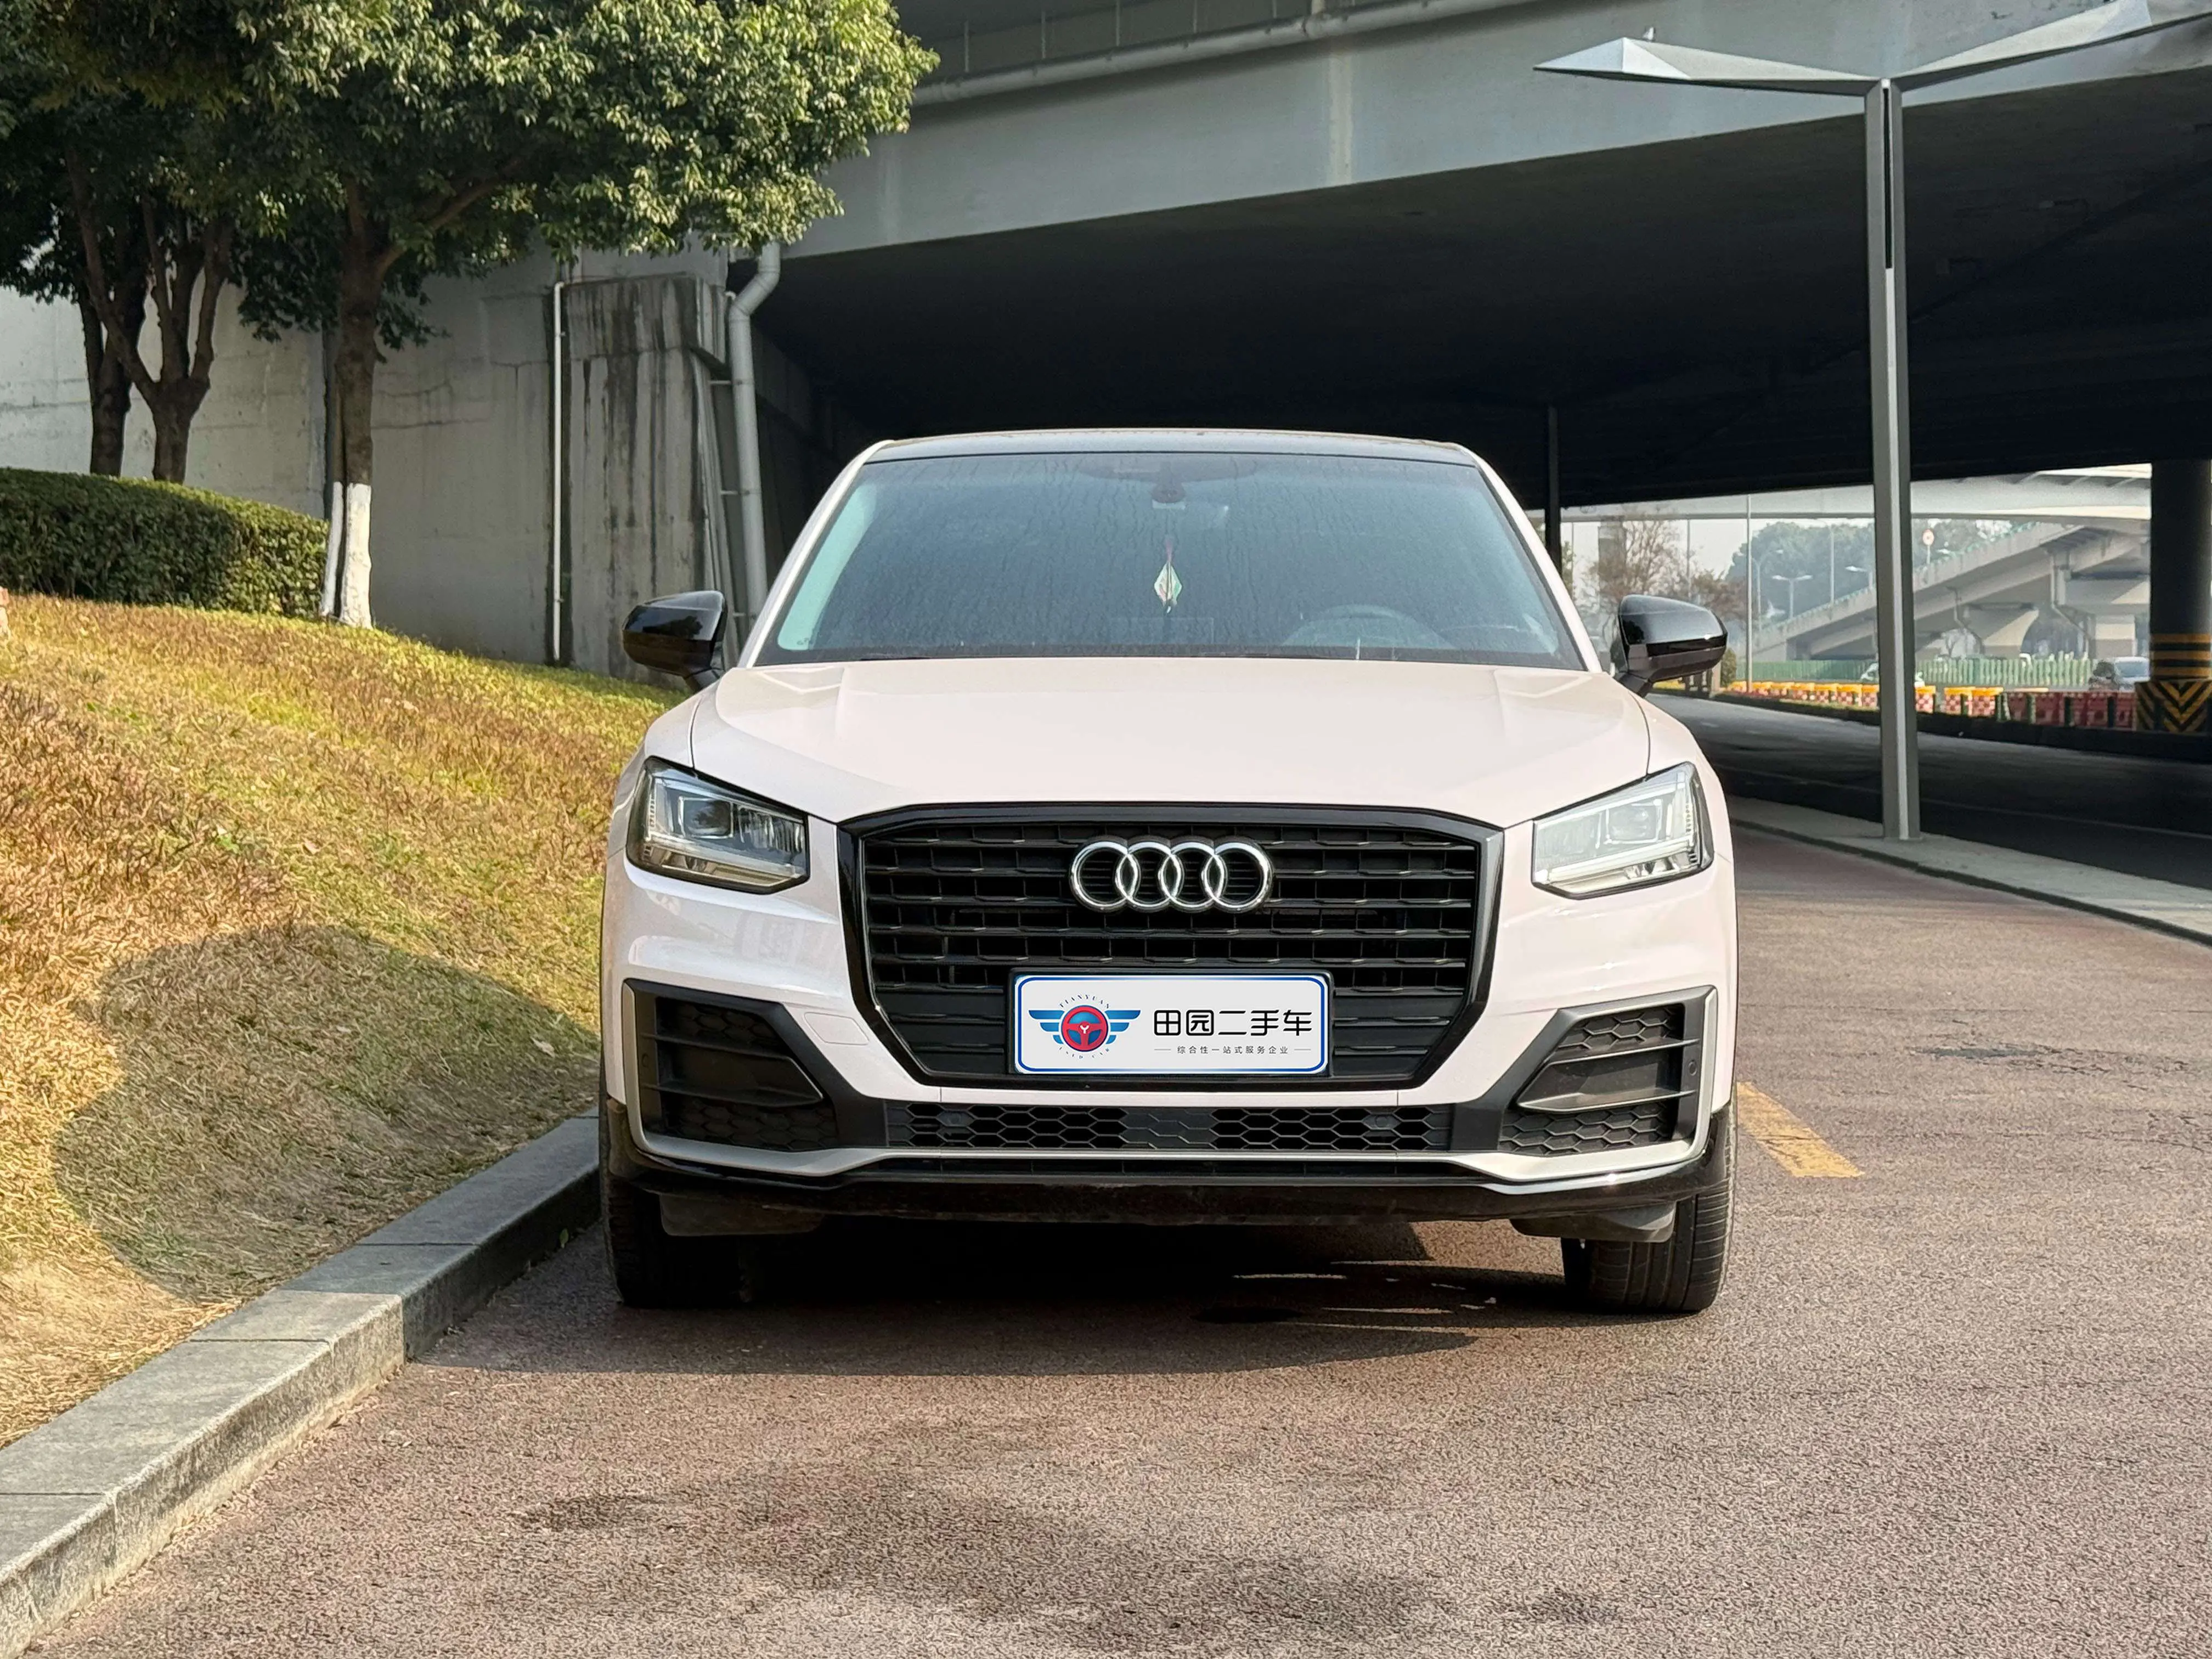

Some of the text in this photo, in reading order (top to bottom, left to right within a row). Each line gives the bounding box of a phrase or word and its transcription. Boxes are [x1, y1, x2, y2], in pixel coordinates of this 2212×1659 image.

[1154, 1009, 1312, 1036] 田园二手车
[1177, 1045, 1288, 1054] 综合性一站式服务企业
